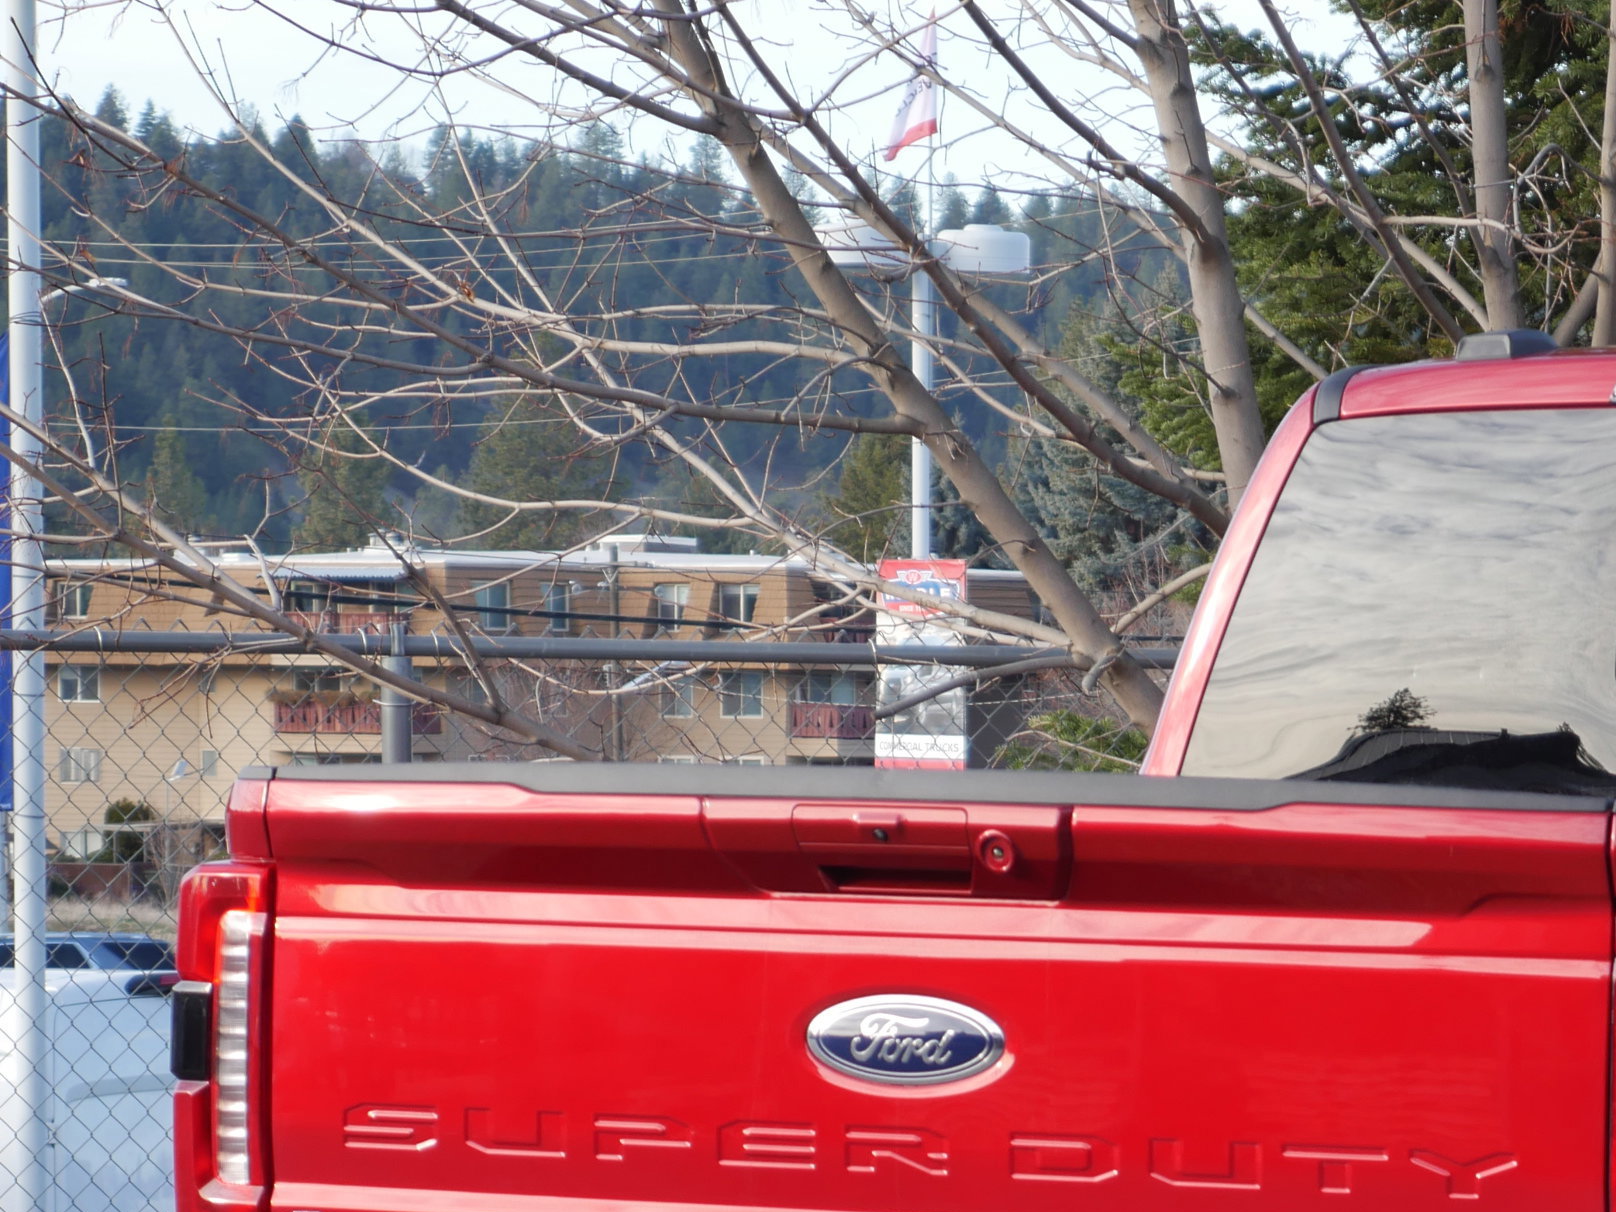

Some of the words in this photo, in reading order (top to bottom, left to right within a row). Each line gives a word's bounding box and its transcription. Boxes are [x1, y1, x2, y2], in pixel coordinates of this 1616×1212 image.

[850, 1012, 956, 1065] Ford
[344, 1102, 949, 1177] SUPER
[1009, 1132, 1519, 1200] DUTY
